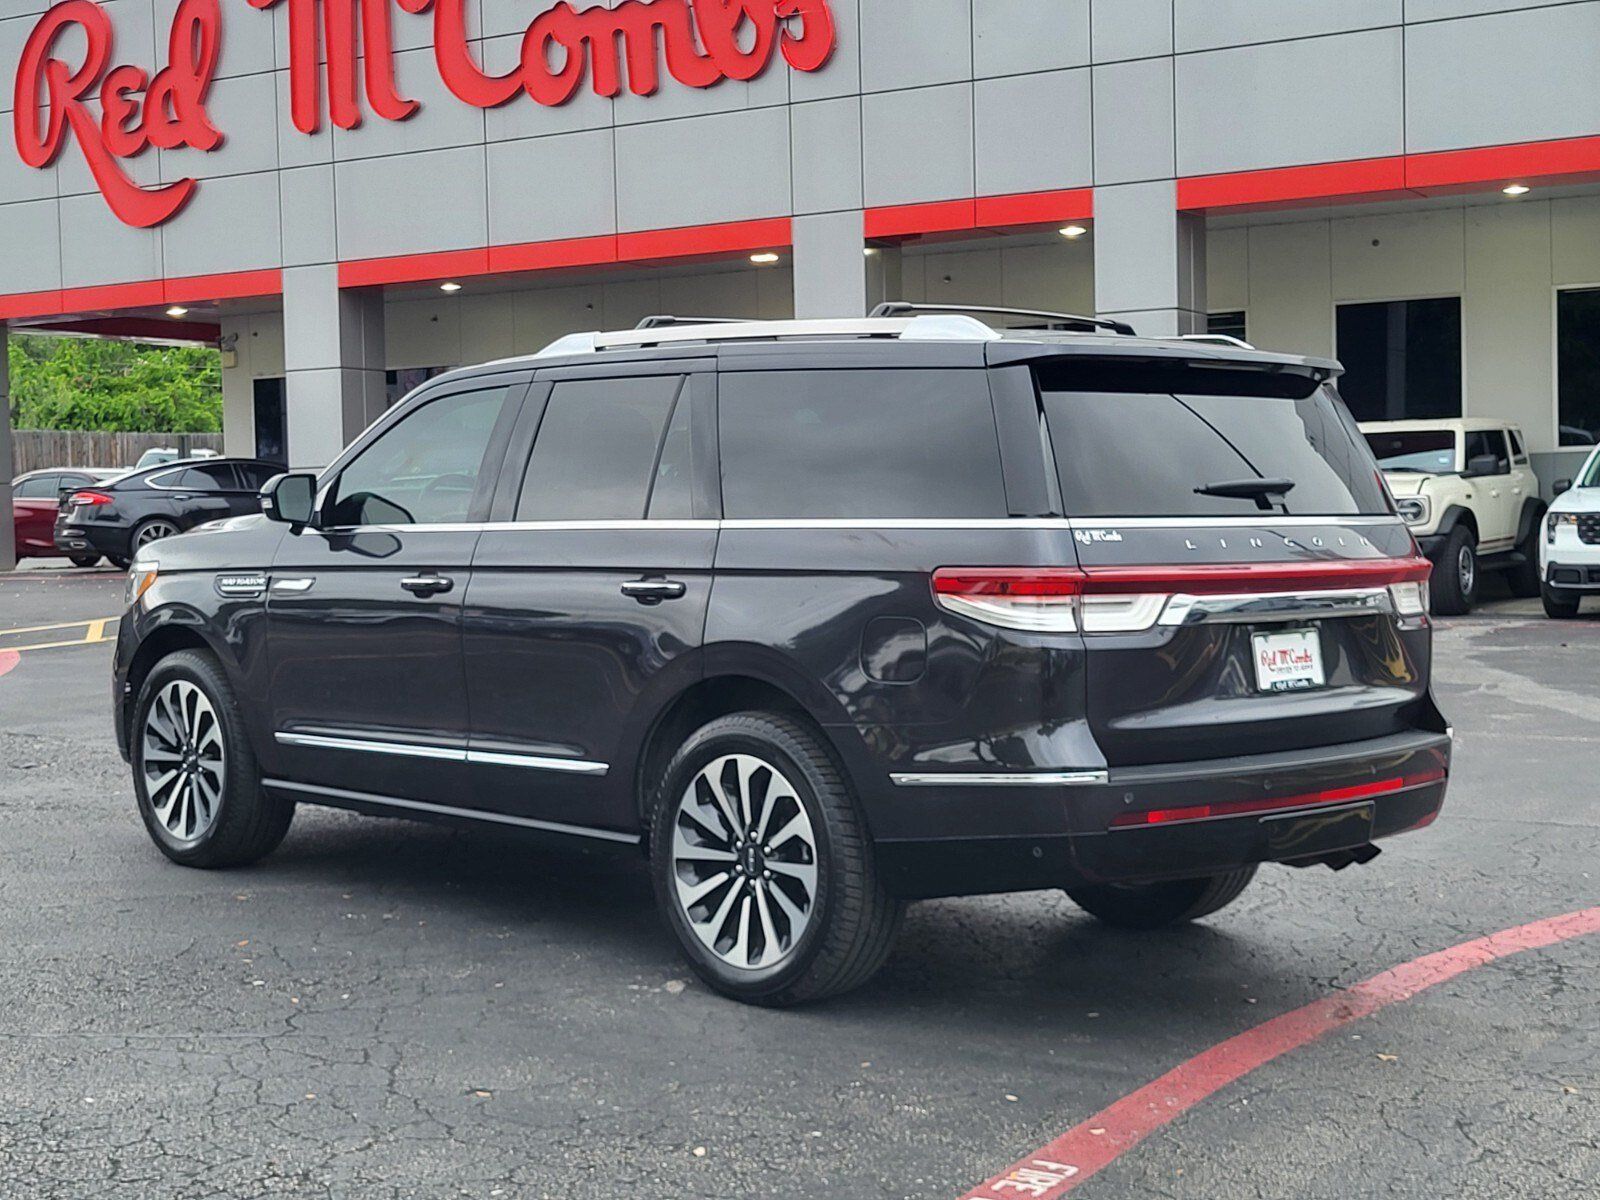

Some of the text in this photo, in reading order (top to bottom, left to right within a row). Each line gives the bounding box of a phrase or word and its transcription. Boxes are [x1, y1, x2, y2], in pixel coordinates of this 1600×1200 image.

[14, 0, 835, 228] Red MCombs
[1185, 535, 1370, 550] LINCOLN
